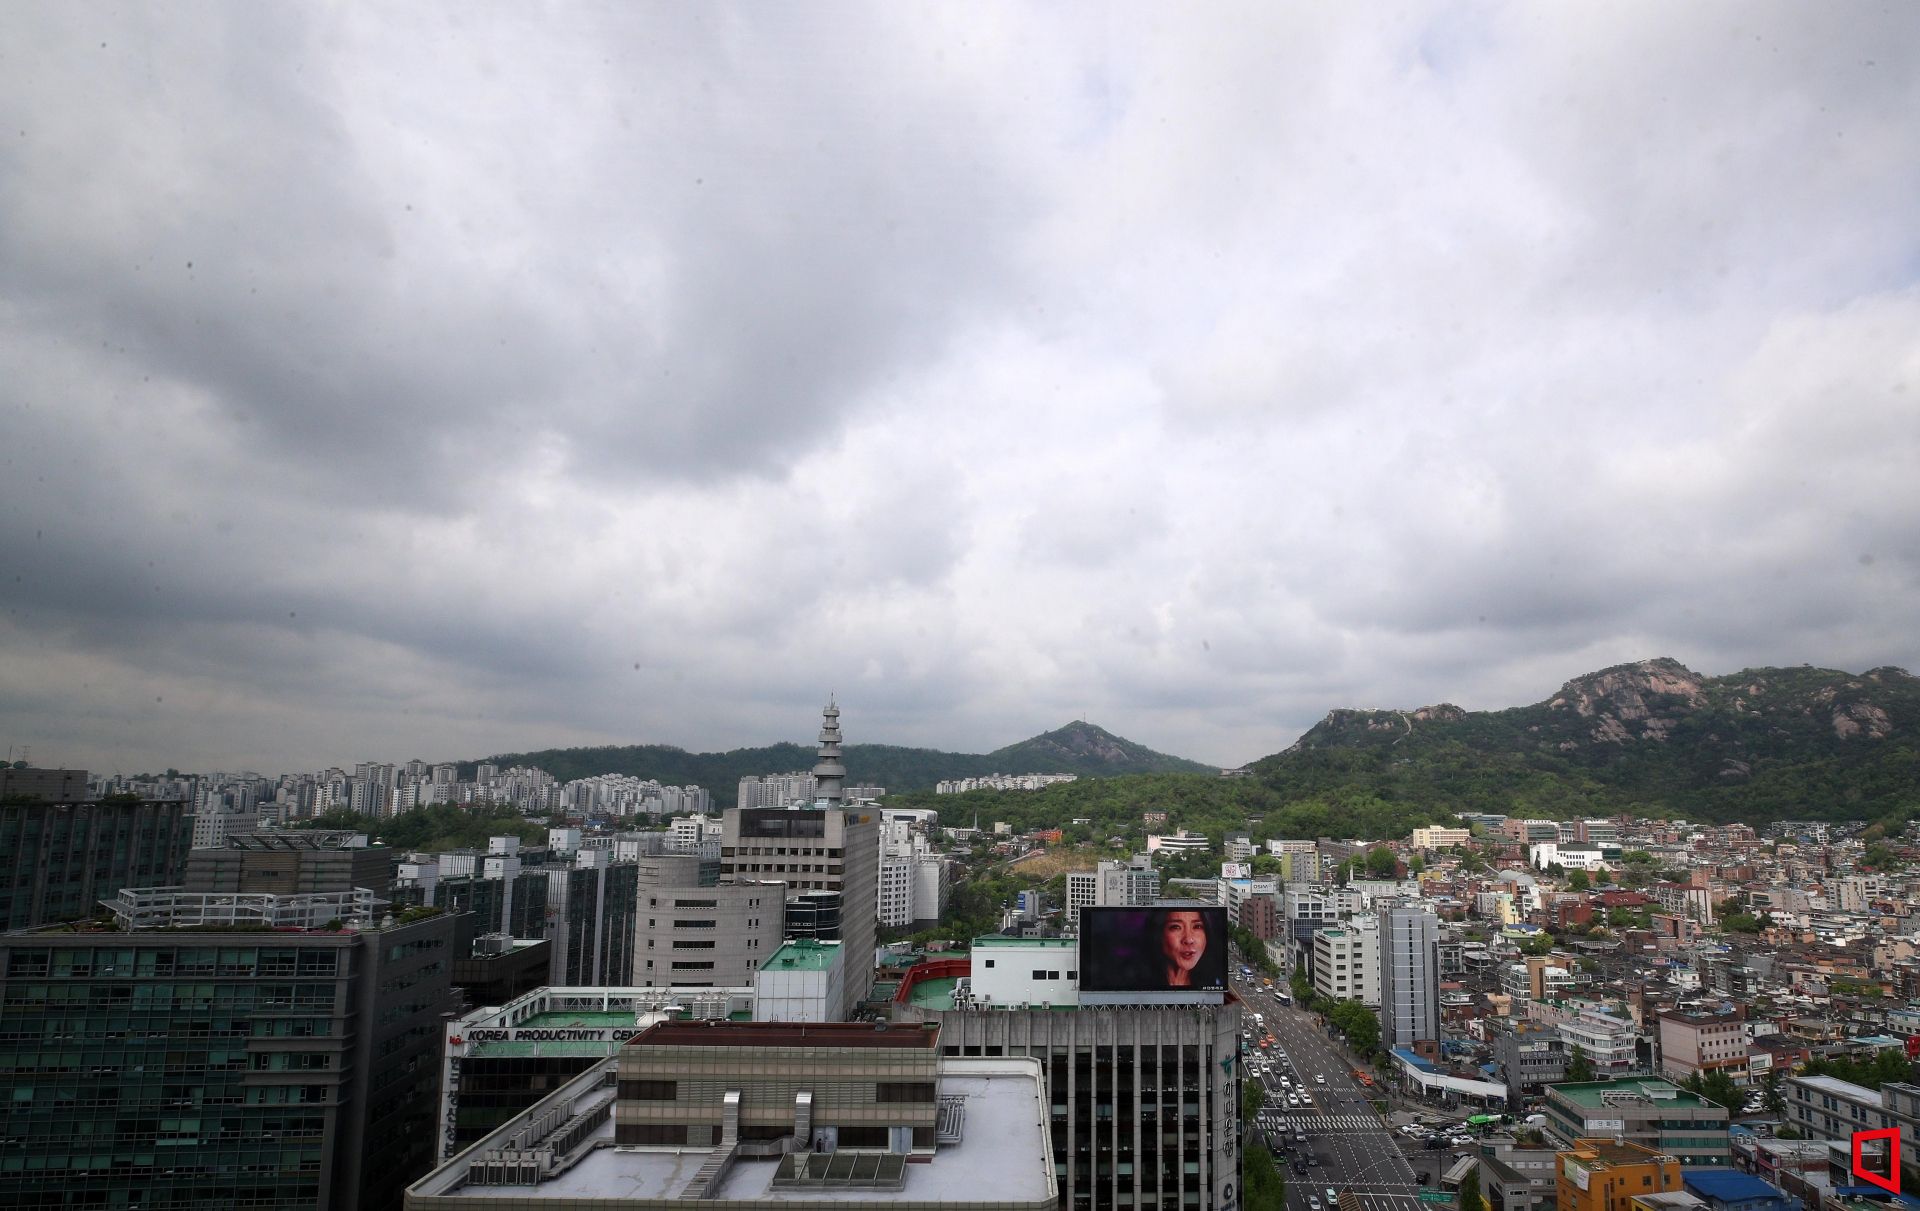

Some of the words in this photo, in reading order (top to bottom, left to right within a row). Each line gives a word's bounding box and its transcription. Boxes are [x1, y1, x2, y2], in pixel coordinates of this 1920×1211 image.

[468, 1030, 509, 1041] KOREA
[515, 1030, 604, 1041] PRODUCTIVITY
[1223, 1080, 1234, 1157] 하나은행
